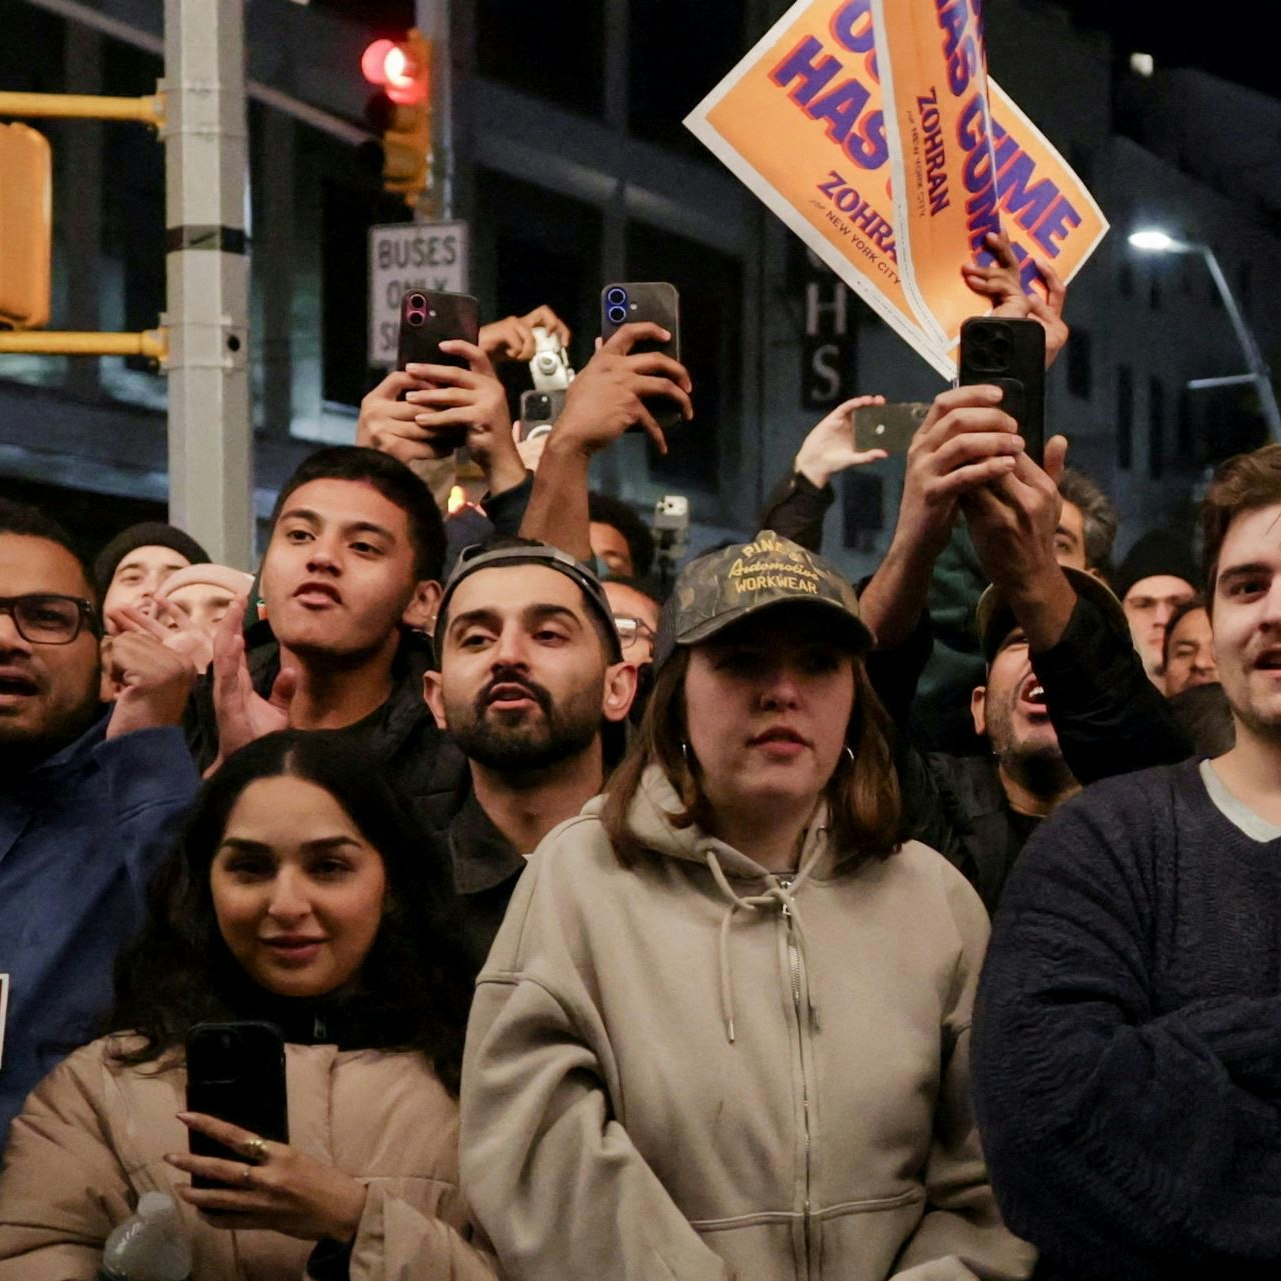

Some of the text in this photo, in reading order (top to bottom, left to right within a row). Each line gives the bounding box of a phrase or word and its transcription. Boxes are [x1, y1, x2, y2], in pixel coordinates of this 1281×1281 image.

[935, 0, 977, 97] AS
[768, 35, 889, 170] HAS
[916, 85, 950, 217] ZOHRAN
[379, 235, 456, 270] BUSES
[826, 211, 851, 236] NEW
[850, 234, 878, 263] YORK
[877, 261, 901, 285] CITY
[729, 558, 820, 581] Automotive
[735, 575, 818, 594] WORKWEAR
